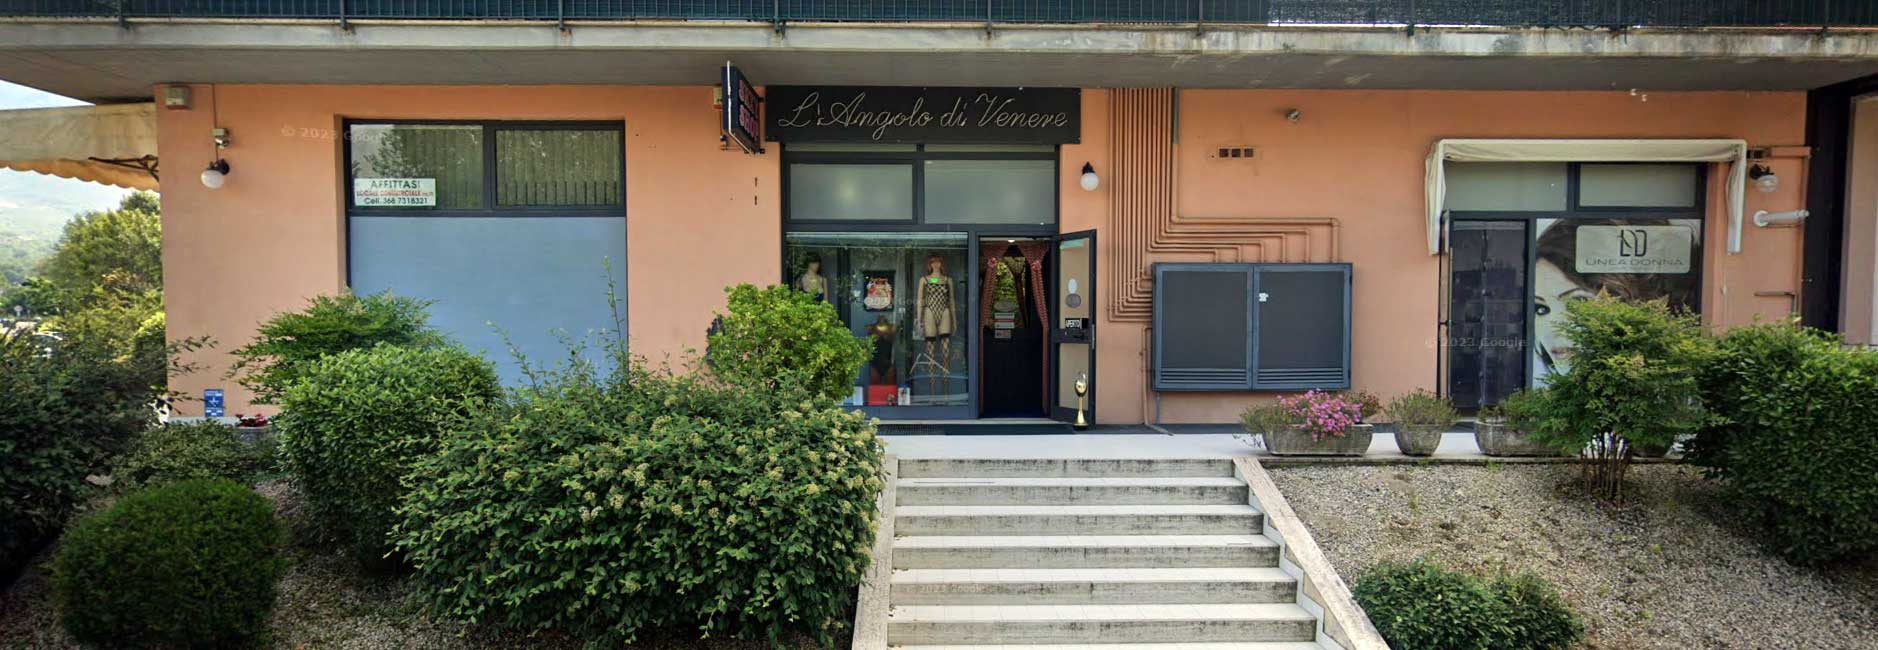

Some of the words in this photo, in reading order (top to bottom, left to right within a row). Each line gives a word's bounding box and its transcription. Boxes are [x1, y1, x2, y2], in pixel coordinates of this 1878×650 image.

[778, 91, 932, 140] L'Angolo
[940, 97, 967, 127] di
[974, 93, 1068, 128] Venere
[1585, 258, 1627, 266] LINEA
[1630, 258, 1685, 266] DONNA
